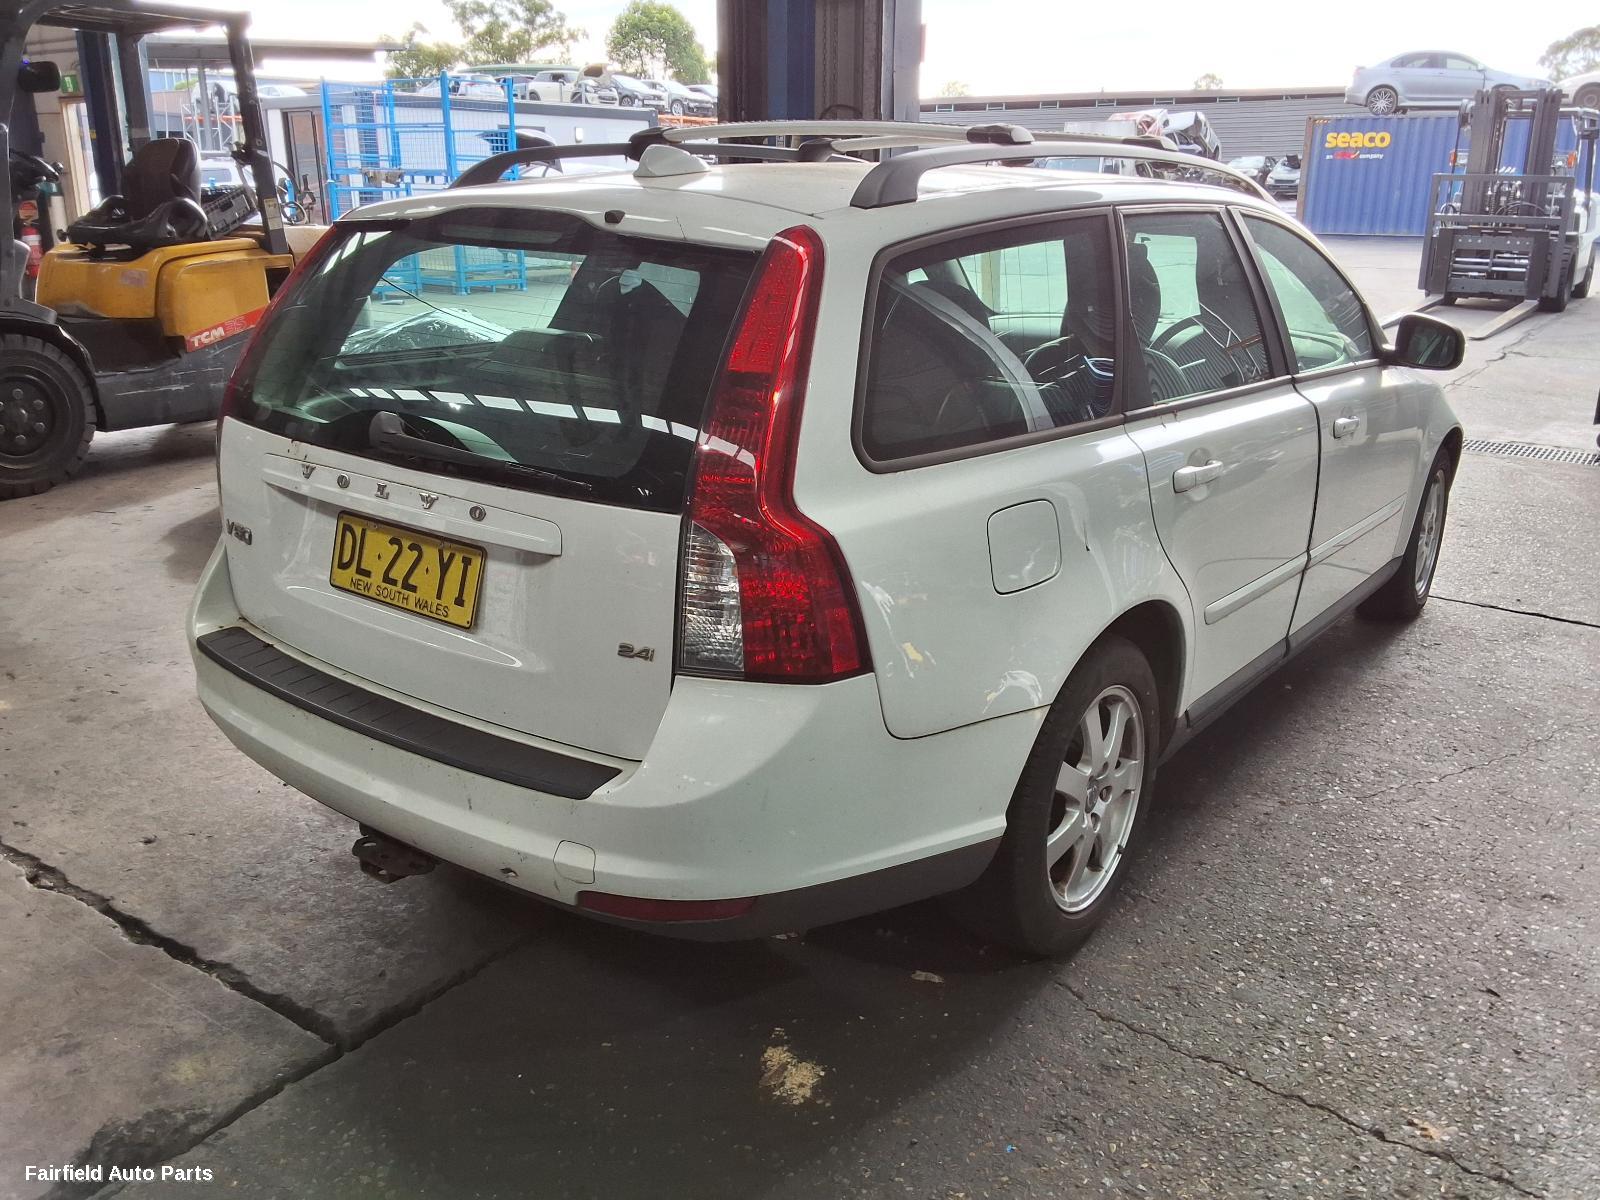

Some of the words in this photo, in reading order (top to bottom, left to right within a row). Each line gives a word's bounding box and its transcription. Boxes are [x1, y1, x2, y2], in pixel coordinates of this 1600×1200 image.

[1324, 131, 1391, 149] seaco
[190, 326, 226, 348] TCM
[301, 462, 487, 523] VOLVO
[350, 576, 372, 594] NEW
[375, 585, 410, 605] SOUTH
[414, 596, 450, 619] WALES
